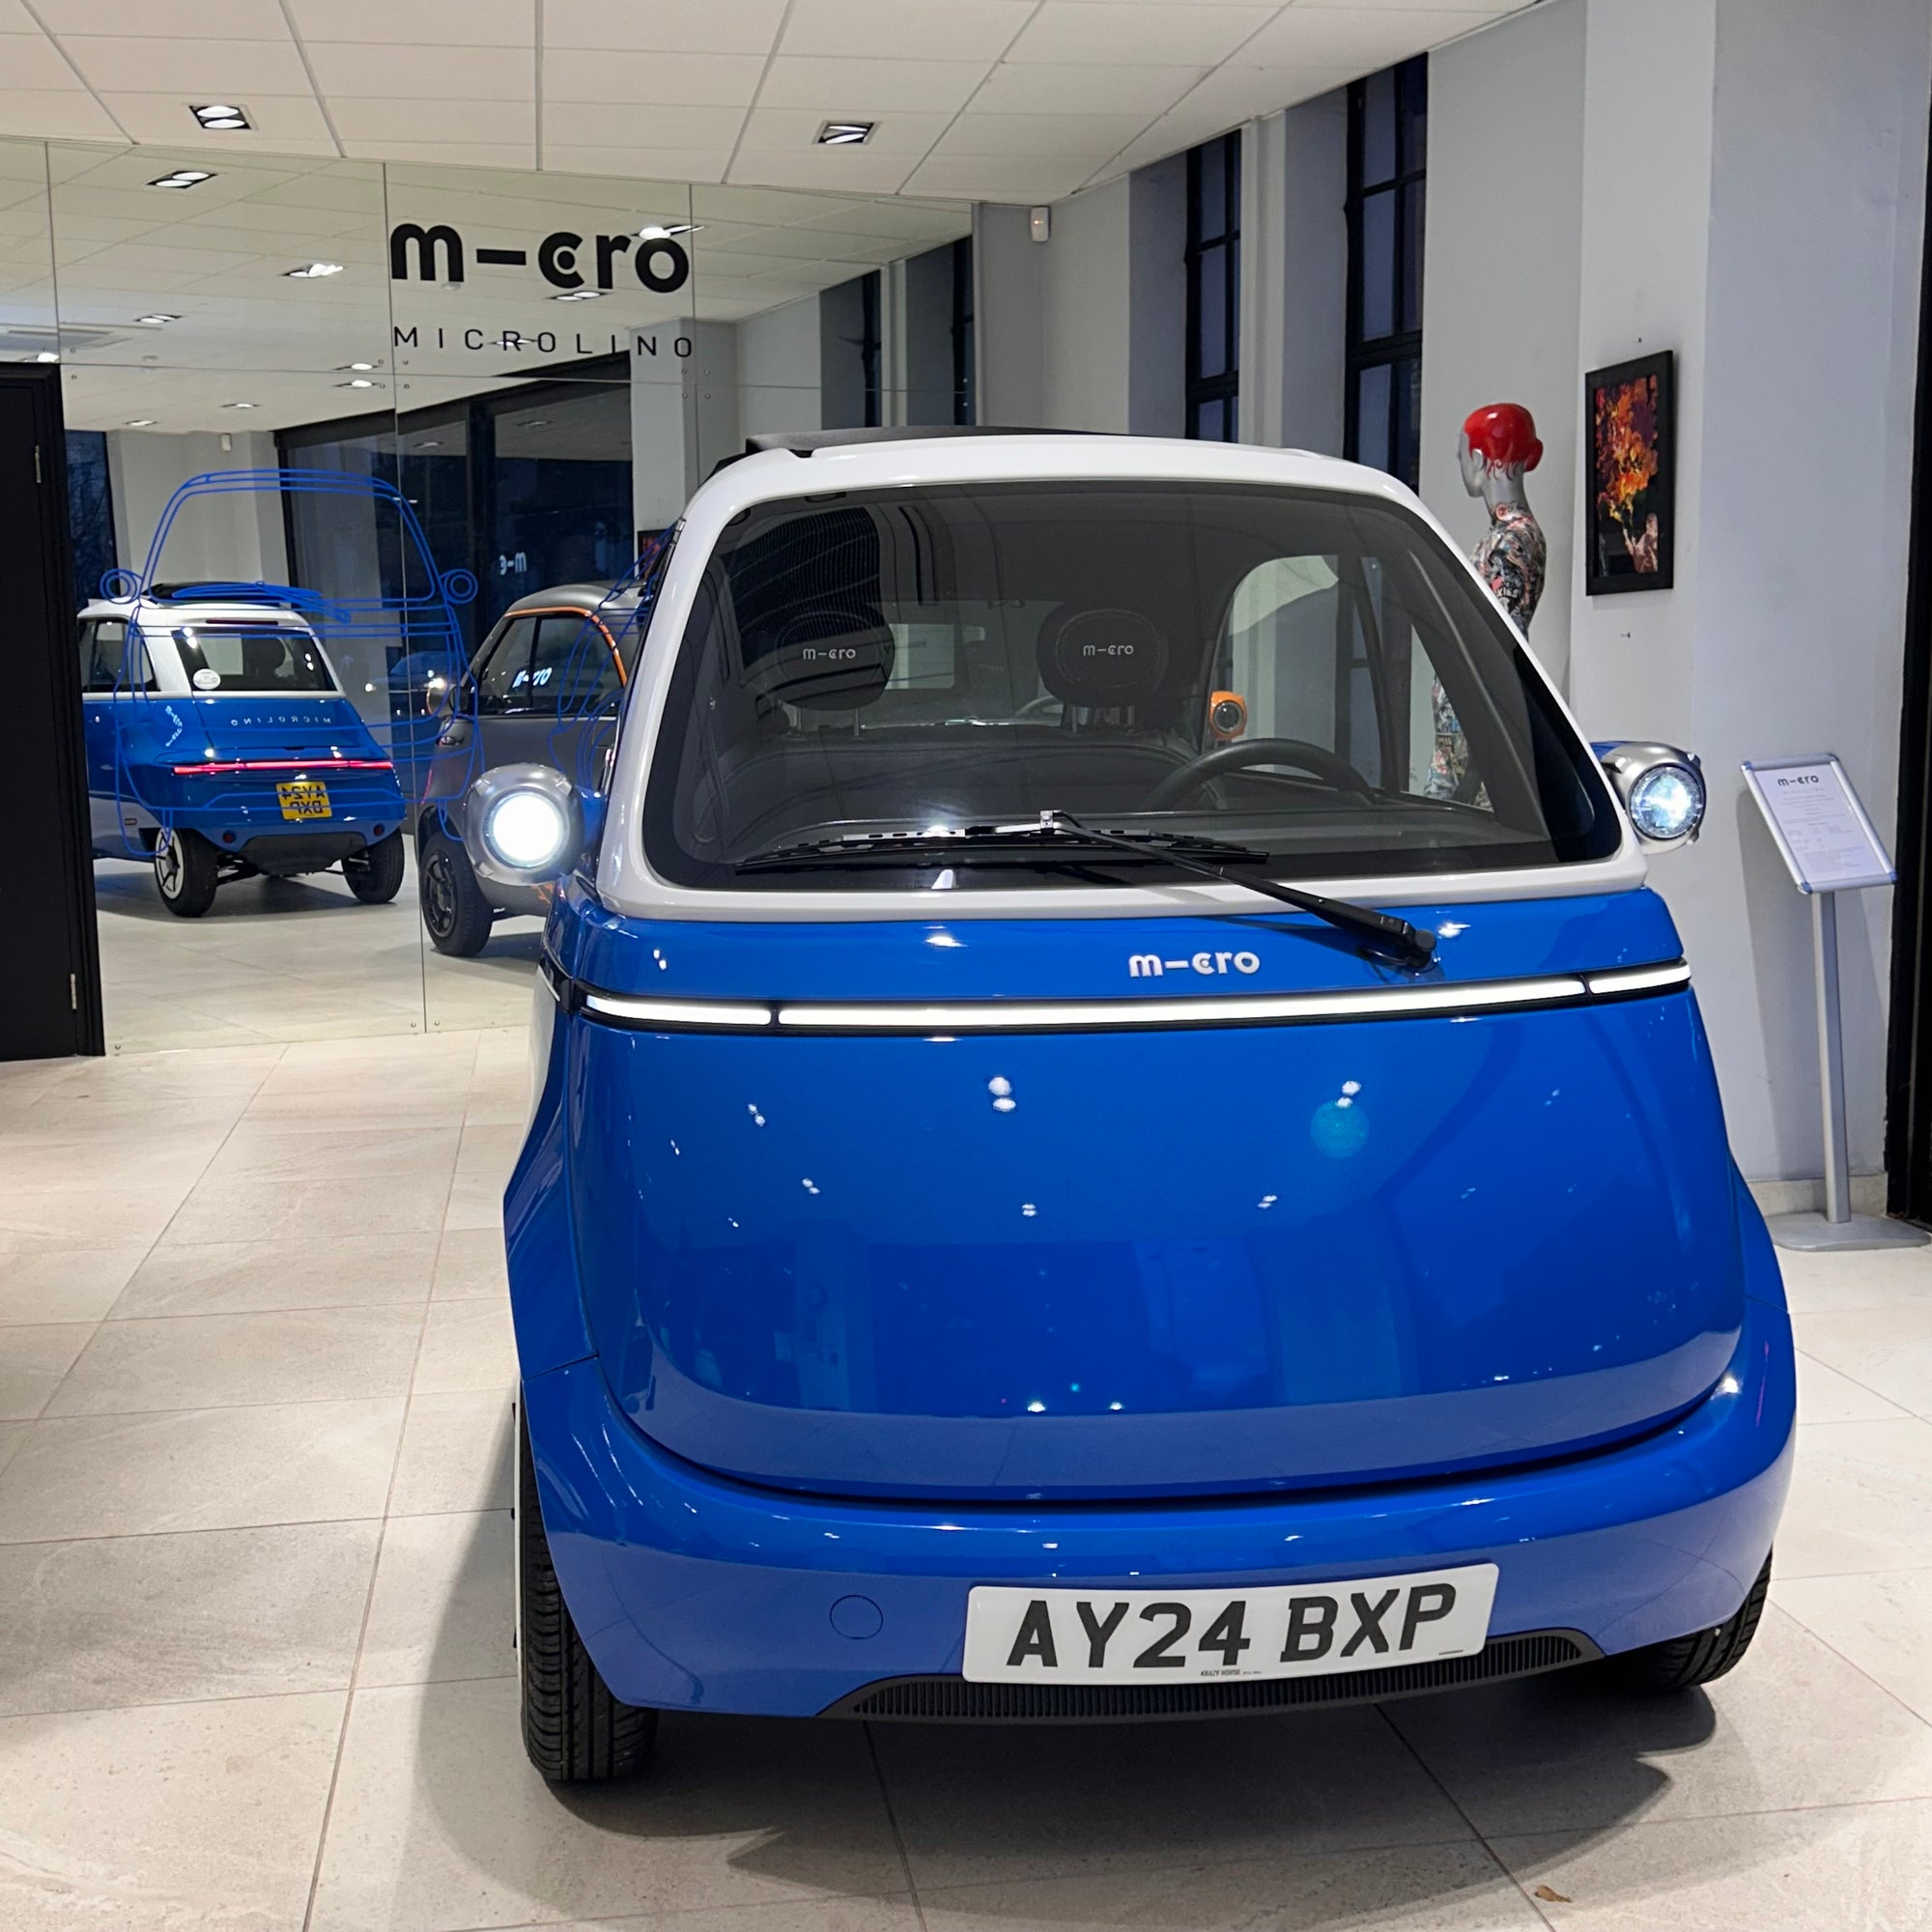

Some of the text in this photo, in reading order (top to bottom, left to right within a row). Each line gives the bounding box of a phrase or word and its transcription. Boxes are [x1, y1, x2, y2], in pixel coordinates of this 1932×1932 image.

[393, 325, 693, 358] MICROLINO
[1006, 1582, 1457, 1668] AY24 BXP
